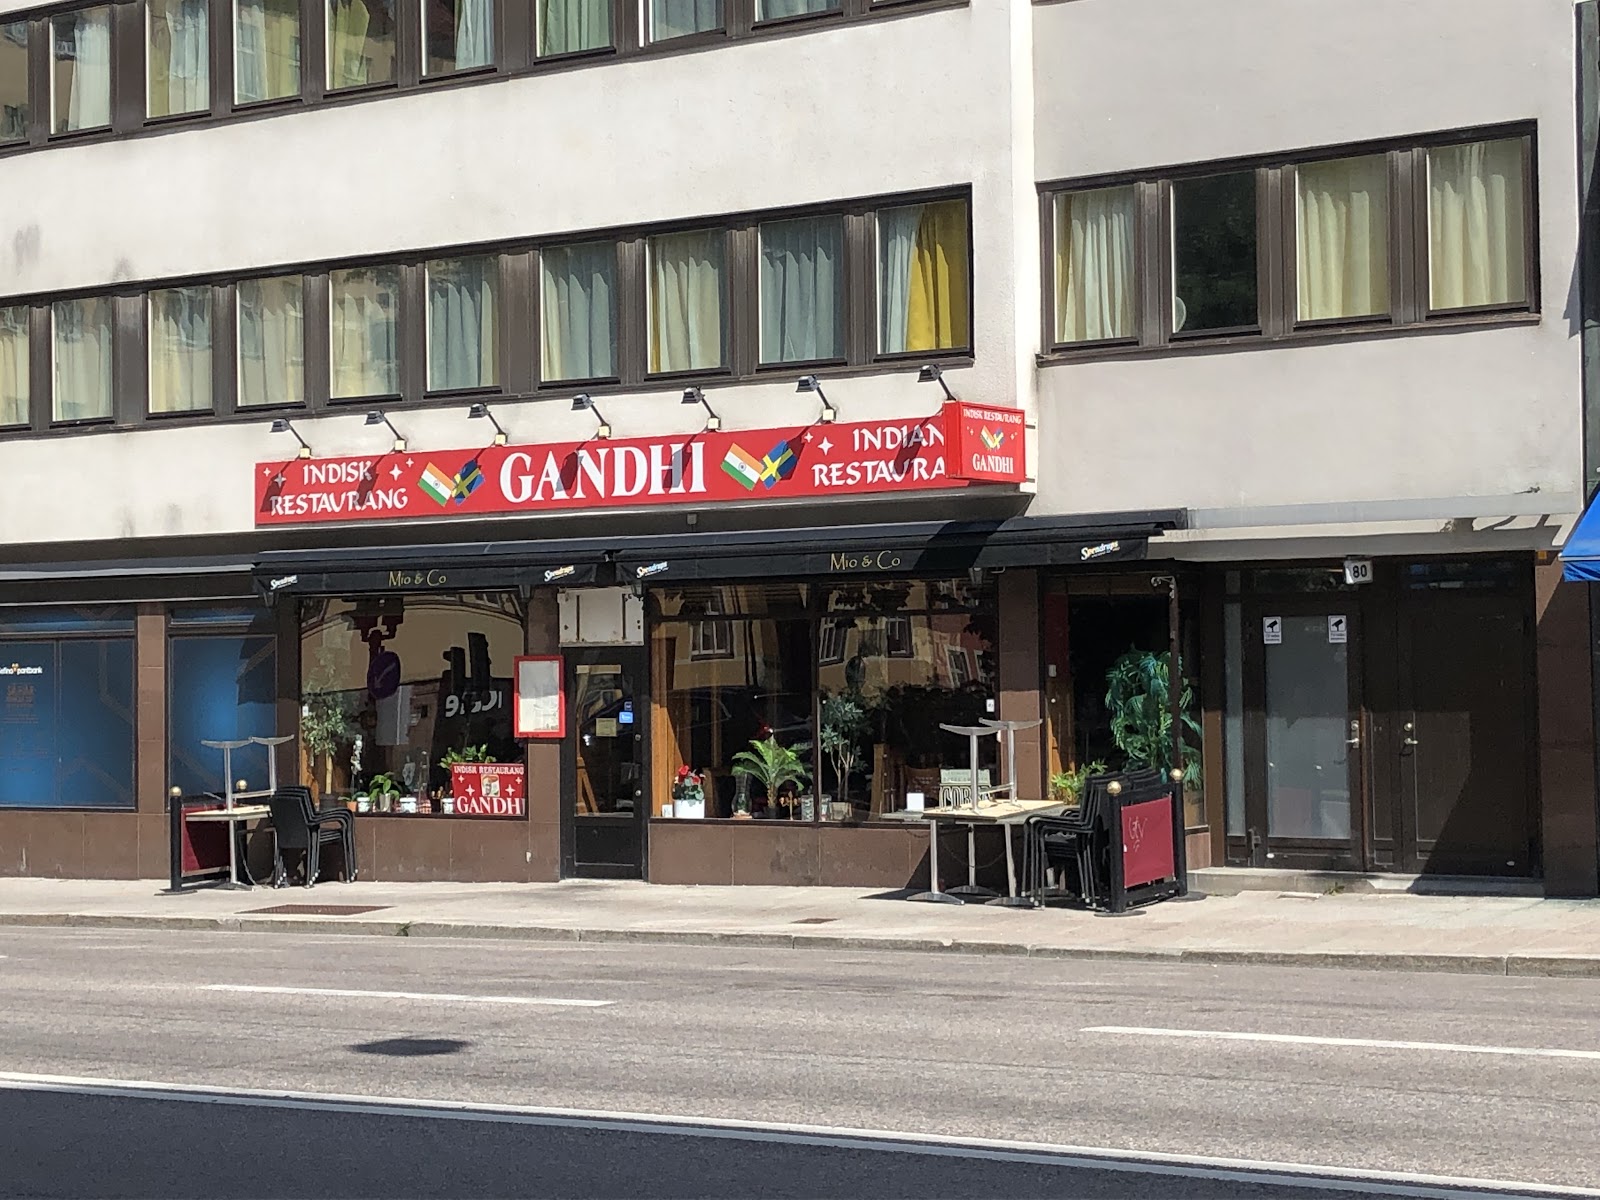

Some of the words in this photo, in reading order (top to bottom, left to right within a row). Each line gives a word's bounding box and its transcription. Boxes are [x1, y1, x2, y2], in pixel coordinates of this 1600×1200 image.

[963, 408, 983, 420] INDISK
[984, 411, 1022, 425] RESTAURANG
[853, 423, 945, 452] INDIAN
[303, 460, 373, 486] INDISK
[500, 441, 707, 504] GANDHI
[811, 456, 946, 487] RESTAURA
[972, 453, 1014, 474] GANDHI
[270, 488, 409, 517] RESTAURANG
[829, 553, 858, 572] Mio
[861, 554, 873, 568] &
[876, 550, 901, 570] Co
[1352, 564, 1368, 578] 80
[388, 570, 411, 588] Mio
[414, 571, 424, 585] &
[426, 569, 447, 587] Co
[456, 795, 526, 815] GANDHI
